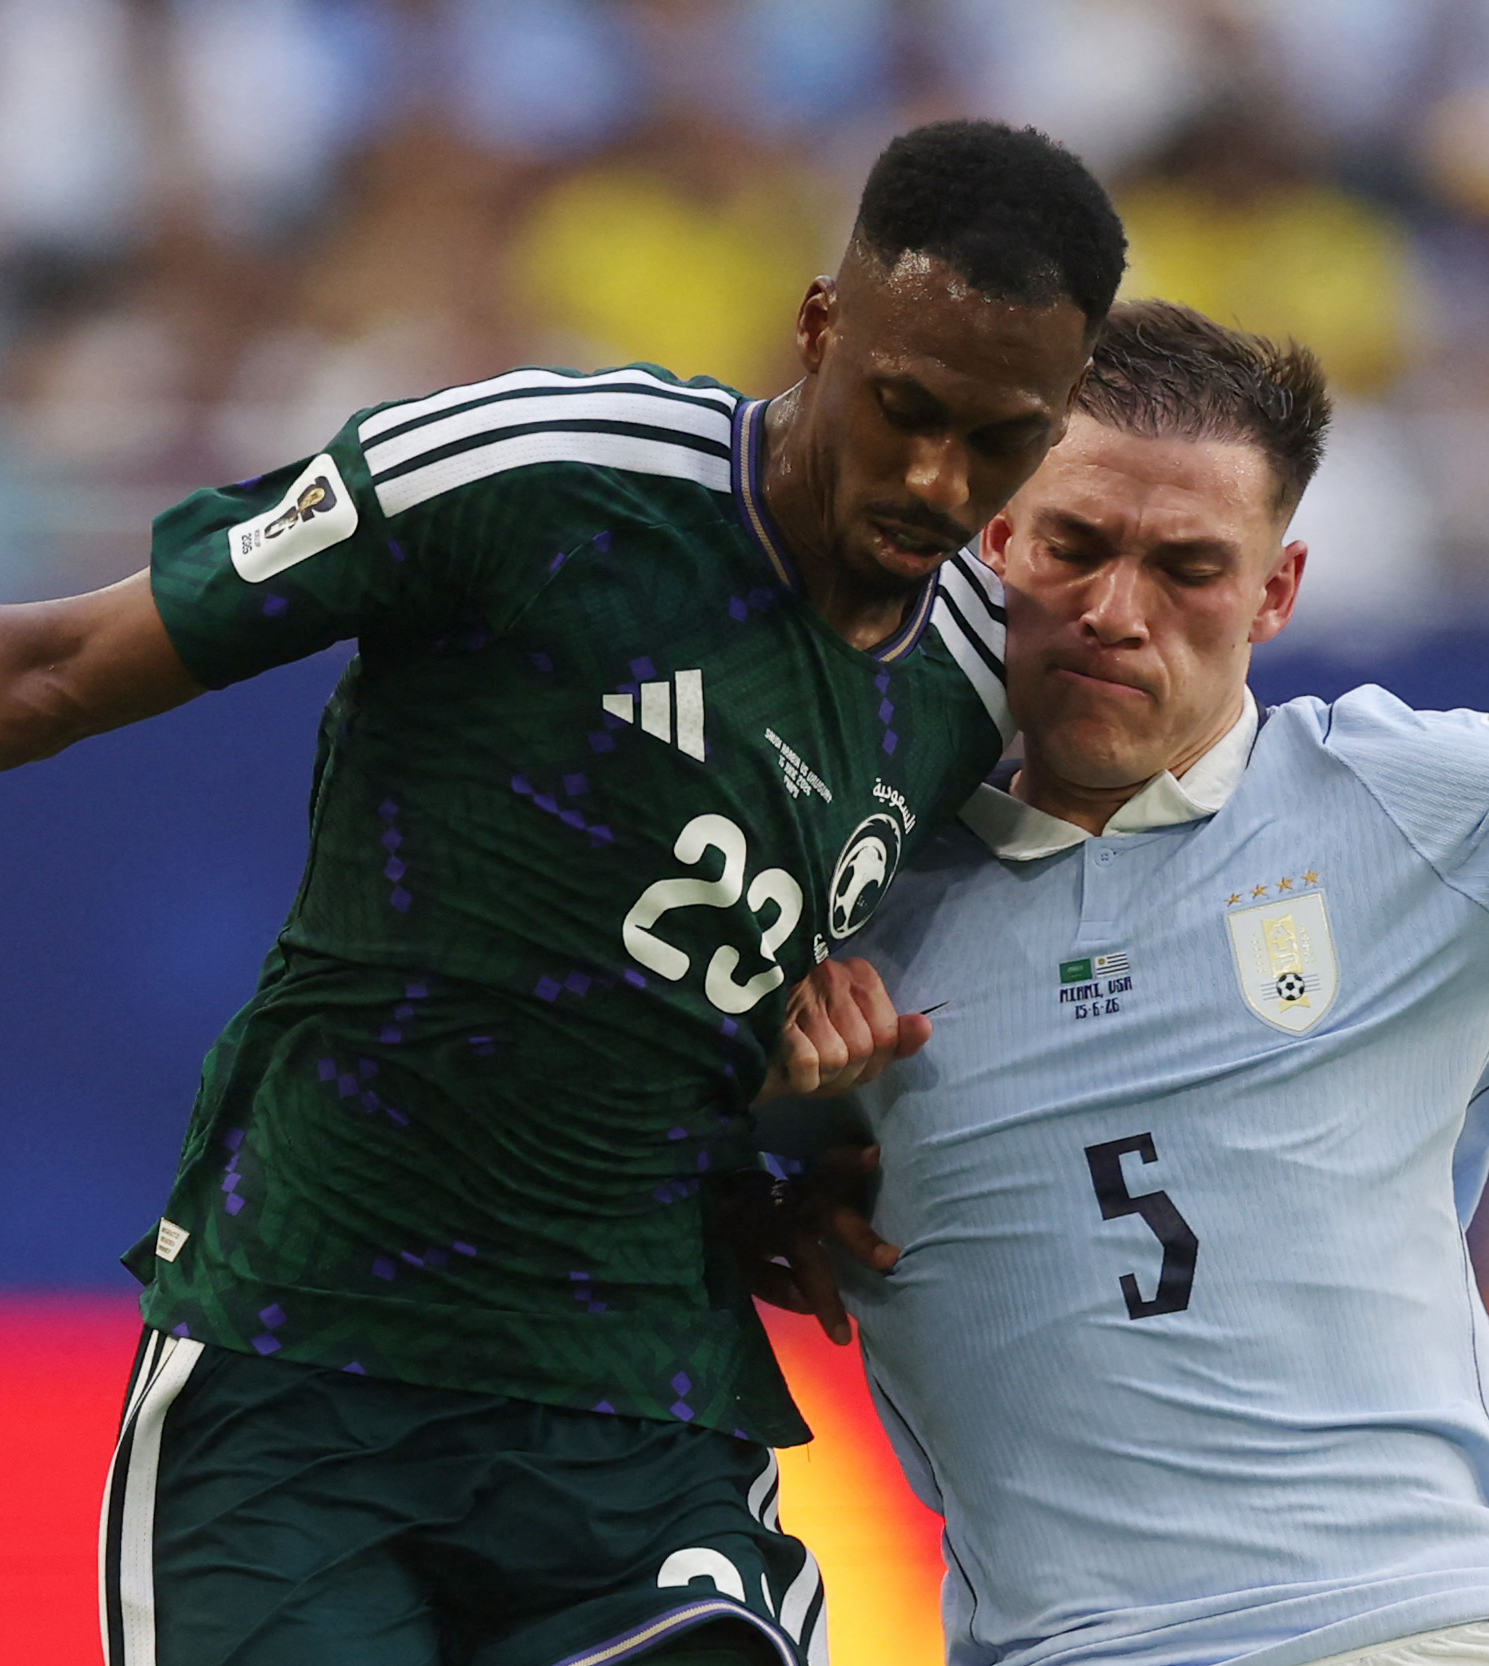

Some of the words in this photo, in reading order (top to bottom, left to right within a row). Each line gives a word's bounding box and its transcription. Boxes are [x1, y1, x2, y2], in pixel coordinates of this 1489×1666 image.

[872, 778, 916, 834] السعودية
[622, 813, 804, 1014] 23
[1059, 982, 1105, 1004] MIAMI,
[1107, 976, 1133, 994] USA
[1084, 1131, 1199, 1320] 5
